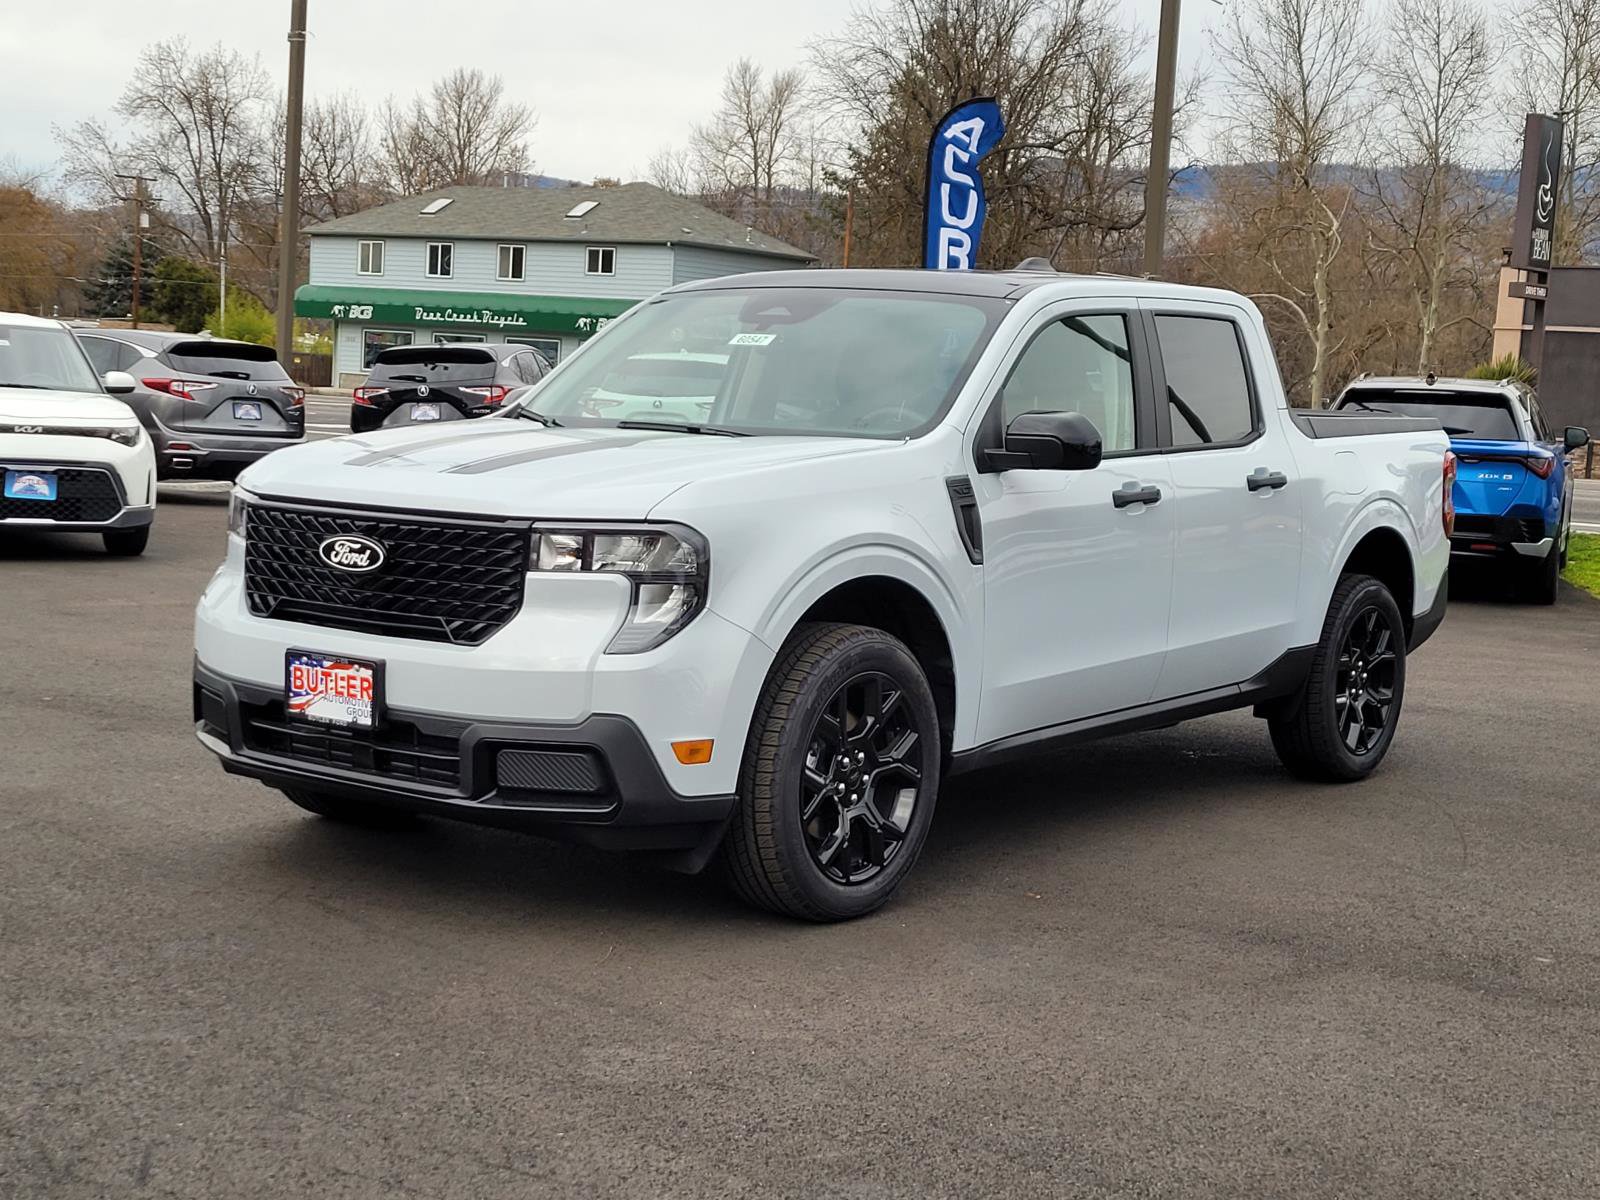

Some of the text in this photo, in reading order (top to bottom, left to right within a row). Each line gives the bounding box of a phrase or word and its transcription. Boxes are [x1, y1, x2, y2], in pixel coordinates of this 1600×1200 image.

[1533, 239, 1551, 260] BEAN
[1525, 286, 1536, 295] DRIVE
[415, 307, 527, 328] Bear Creek Bicycle
[331, 540, 370, 567] Ford
[292, 665, 373, 701] BUTLER
